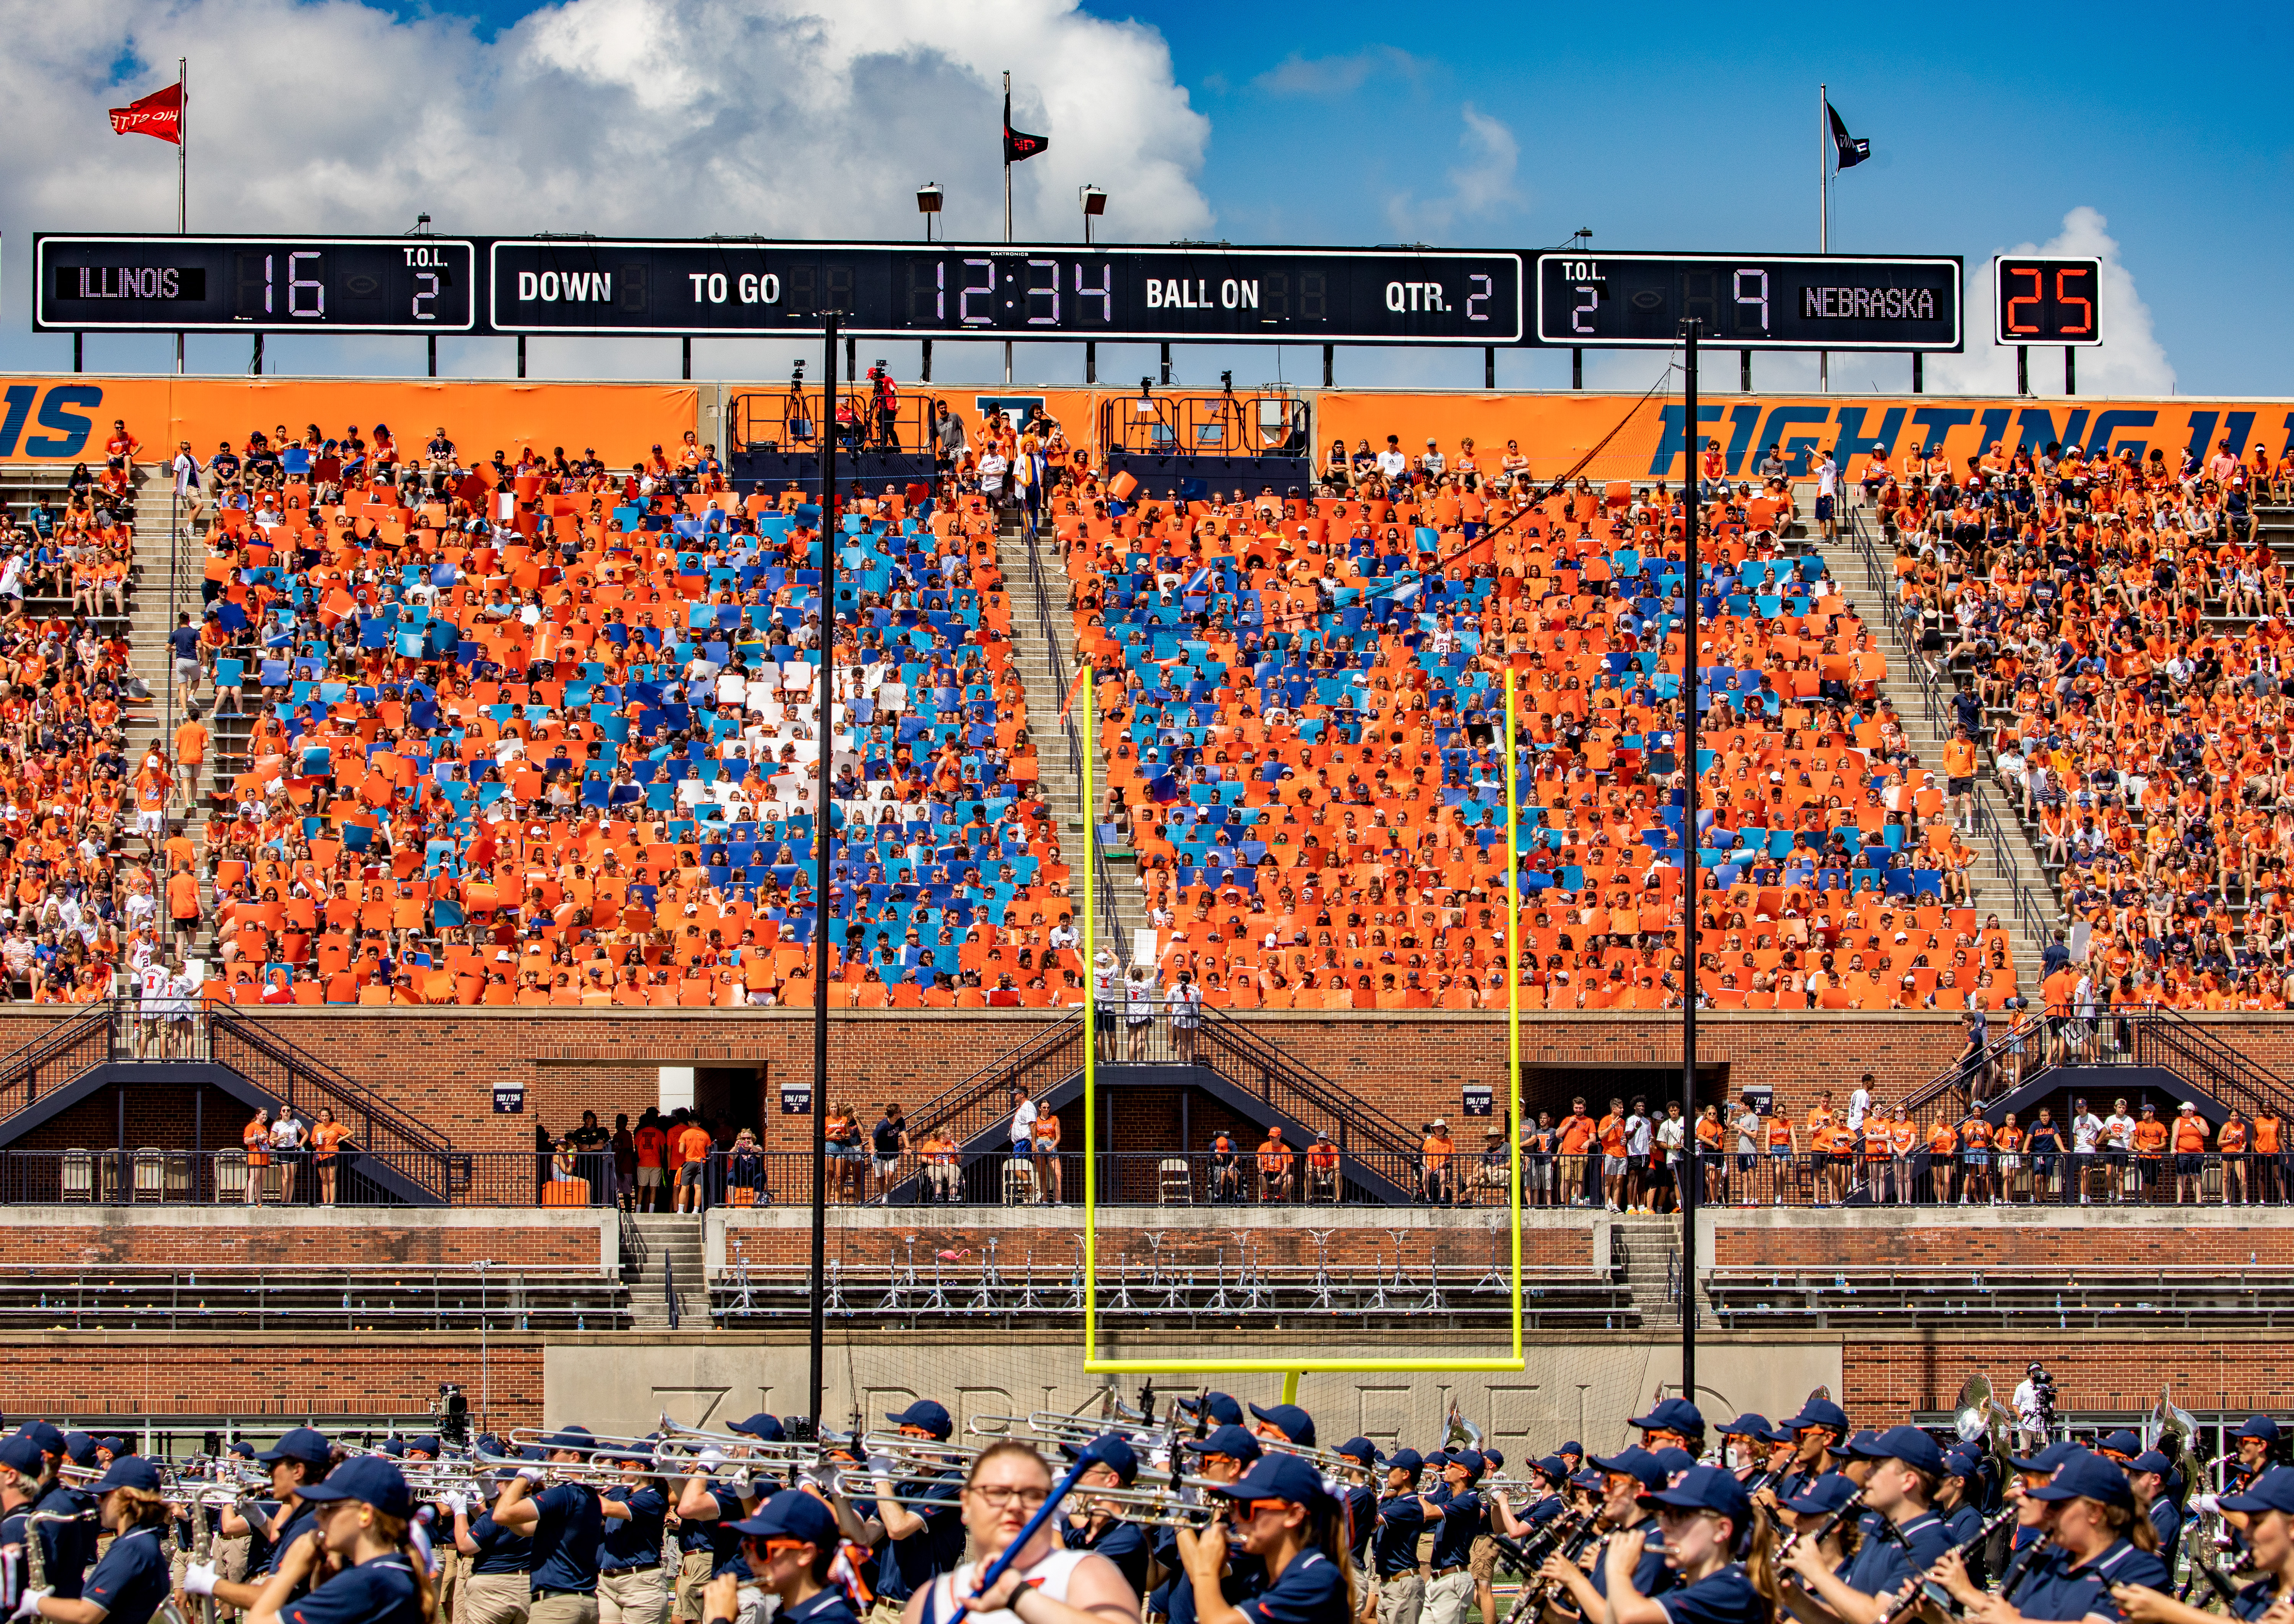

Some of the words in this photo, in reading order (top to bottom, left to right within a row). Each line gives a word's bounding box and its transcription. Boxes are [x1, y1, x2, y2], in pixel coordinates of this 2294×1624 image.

[404, 248, 448, 267] T.O.L.
[1563, 263, 1607, 281] T.O.L.
[79, 267, 178, 298] ILLINOIS
[265, 252, 323, 317] 16
[413, 273, 438, 319] 2
[519, 272, 611, 302] DOWN
[689, 273, 727, 303] TO
[740, 274, 780, 304] GO
[936, 258, 1111, 324] 12:34
[1147, 279, 1213, 308] BALL
[1221, 279, 1258, 309] ON
[1386, 281, 1451, 312] QTR.
[1467, 274, 1492, 320] 2
[1572, 286, 1599, 333] 2
[1733, 268, 1768, 330] 9
[1805, 287, 1934, 318] NEBRASKA
[2007, 268, 2091, 333] 25
[1648, 404, 2159, 477] FIGHTING
[12, 708, 20, 721] 7
[1958, 746, 1964, 755] I
[2194, 843, 2201, 853] I
[148, 976, 155, 989] I
[167, 984, 173, 996] I
[1100, 977, 1109, 989] I
[642, 1132, 655, 1149] I
[2008, 1136, 2017, 1149] I
[2034, 1128, 2055, 1136] ILLINOIS
